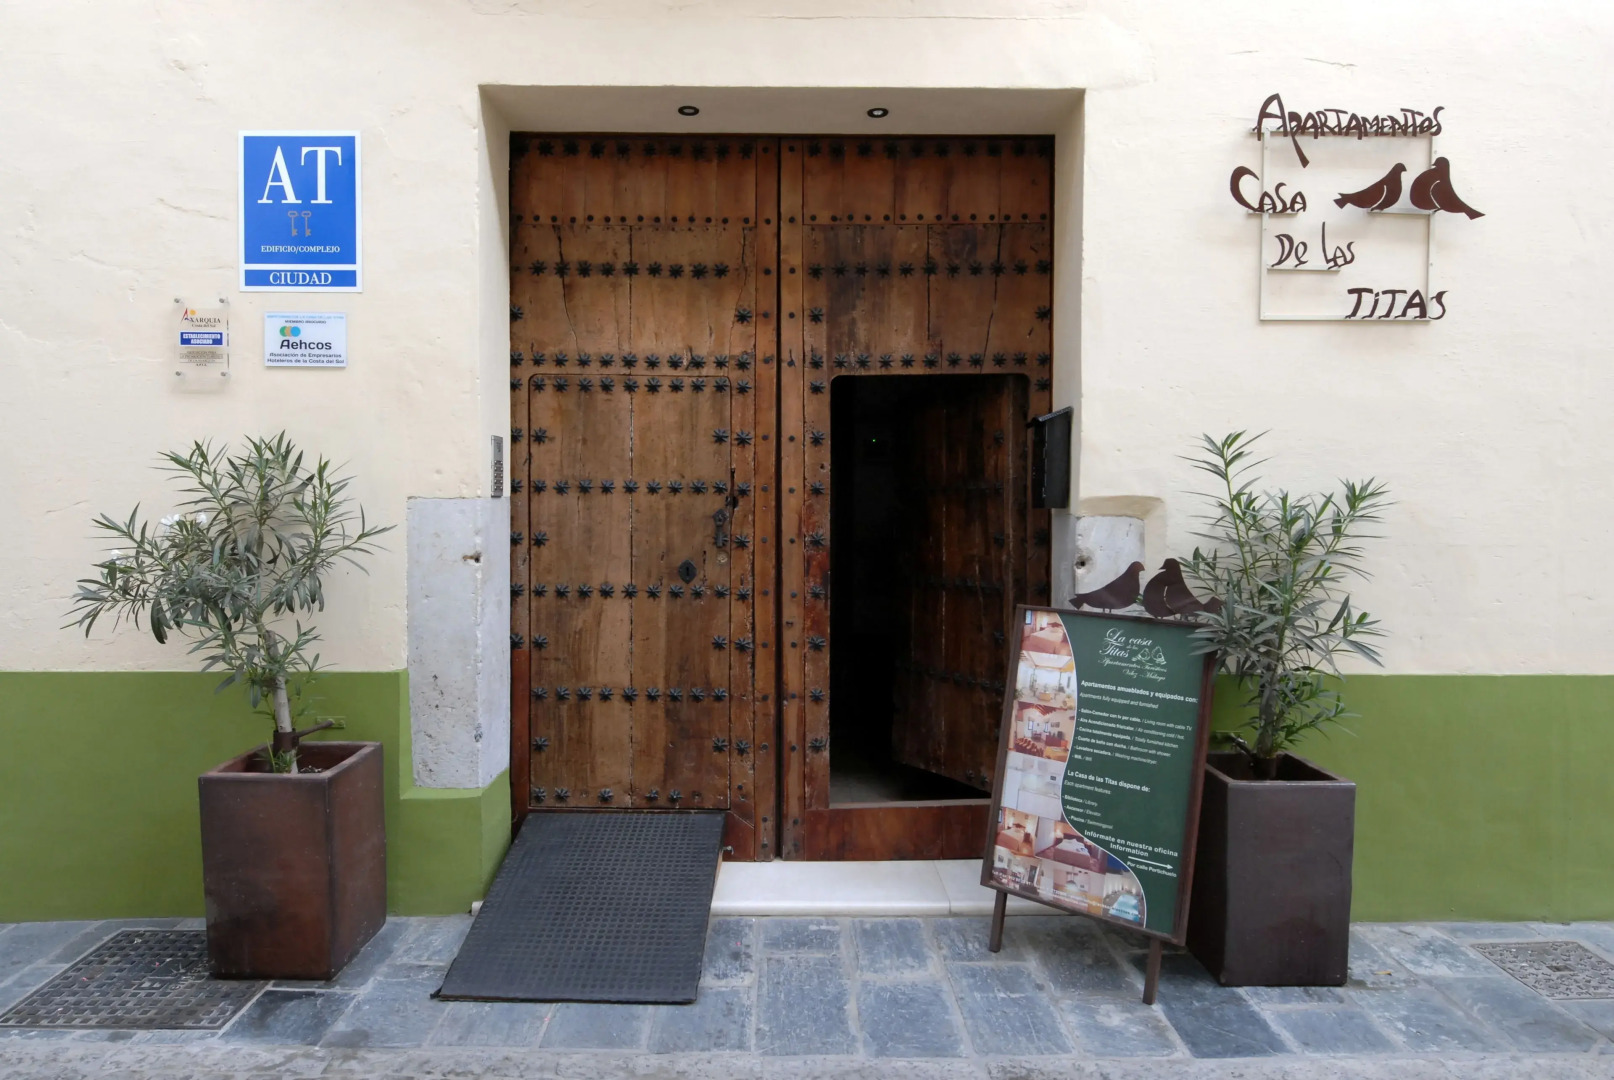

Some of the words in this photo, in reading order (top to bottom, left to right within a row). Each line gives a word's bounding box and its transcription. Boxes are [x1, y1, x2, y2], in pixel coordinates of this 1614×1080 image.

[257, 145, 342, 204] AT
[260, 245, 340, 254] EDIFICIO/COMPLEJO
[269, 271, 332, 285] CIUDAD
[280, 339, 332, 350] Aehcos
[1128, 637, 1153, 646] casa
[1081, 680, 1116, 691] Apartamentos
[1117, 685, 1150, 696] amueblados
[1155, 692, 1184, 700] equipados
[1075, 771, 1088, 780] Casa
[1105, 777, 1118, 786] Titas
[1118, 780, 1141, 792] dispone
[1110, 843, 1149, 857] Information
[1126, 840, 1153, 852] nuestra
[1154, 846, 1179, 858] oficina
